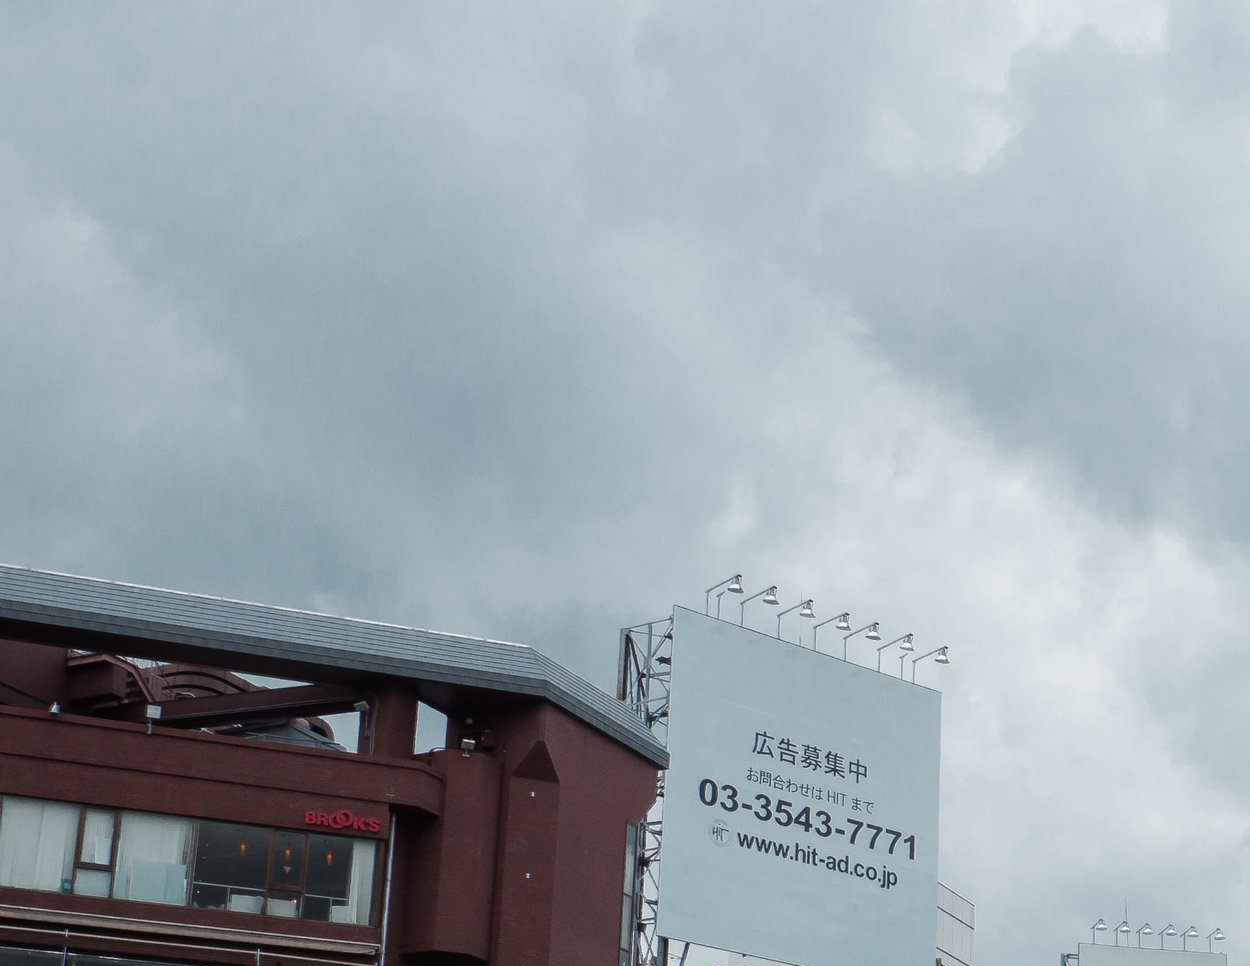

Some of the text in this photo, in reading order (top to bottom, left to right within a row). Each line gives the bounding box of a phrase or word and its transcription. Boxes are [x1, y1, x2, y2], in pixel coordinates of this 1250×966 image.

[751, 730, 869, 785] 広告募集中
[698, 777, 918, 861] 03-3543-7771
[746, 766, 875, 815] お問合わせは HIT まで
[736, 828, 899, 890] www.hit-ad.co.jp
